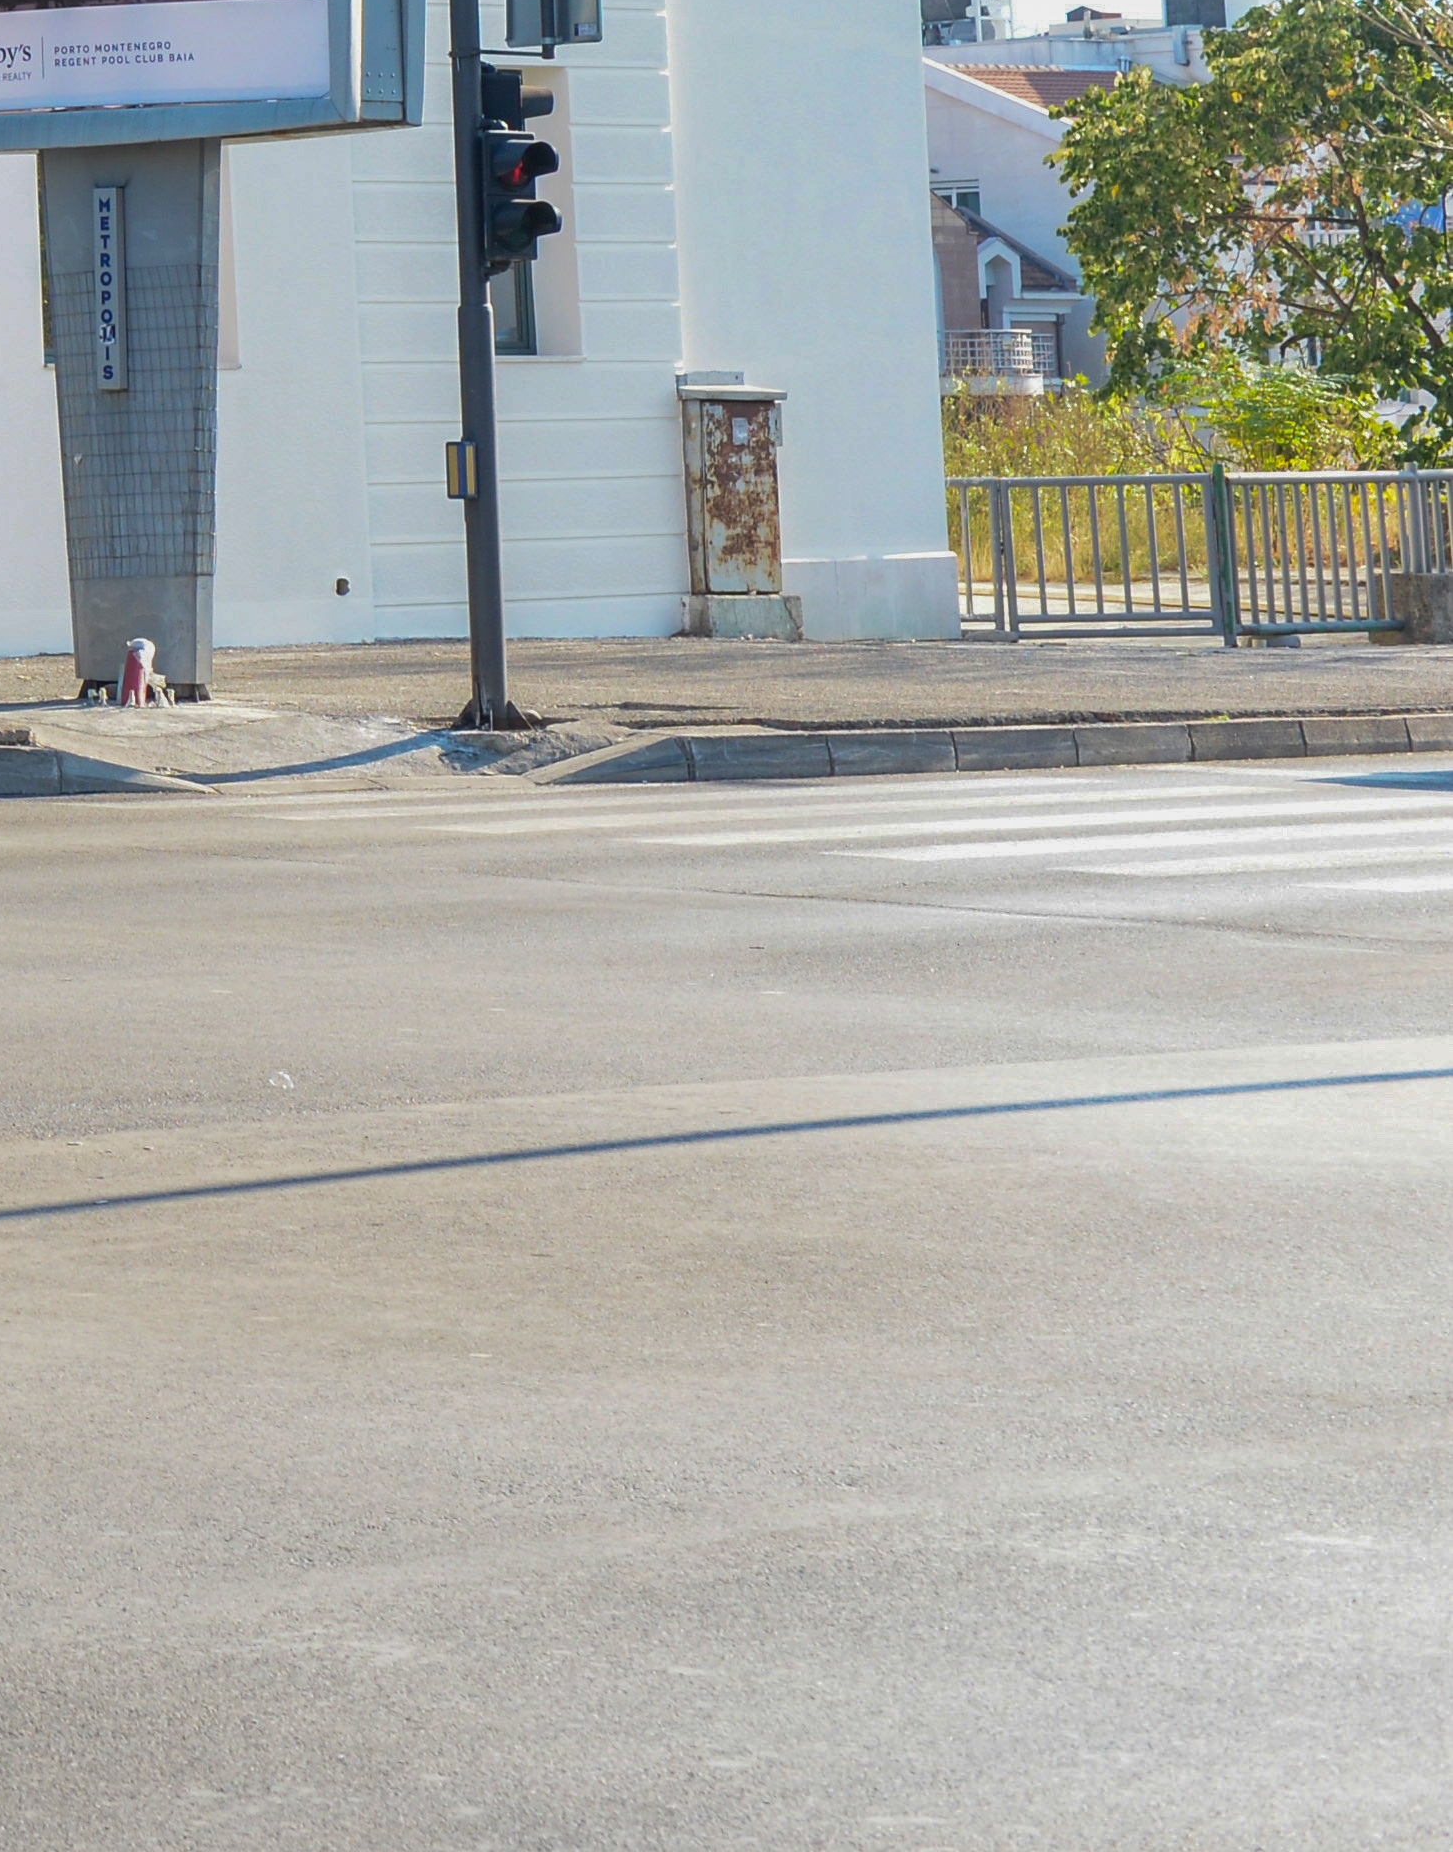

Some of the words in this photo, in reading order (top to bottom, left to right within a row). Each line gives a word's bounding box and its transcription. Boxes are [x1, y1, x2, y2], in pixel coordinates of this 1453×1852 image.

[53, 44, 91, 56] PORTO
[94, 41, 172, 53] MONTENEGRO
[54, 55, 98, 67] REGENT
[101, 53, 131, 65] POOL
[135, 52, 164, 64] CLUB
[169, 51, 196, 62] BAIA
[2, 71, 32, 82] REALTY
